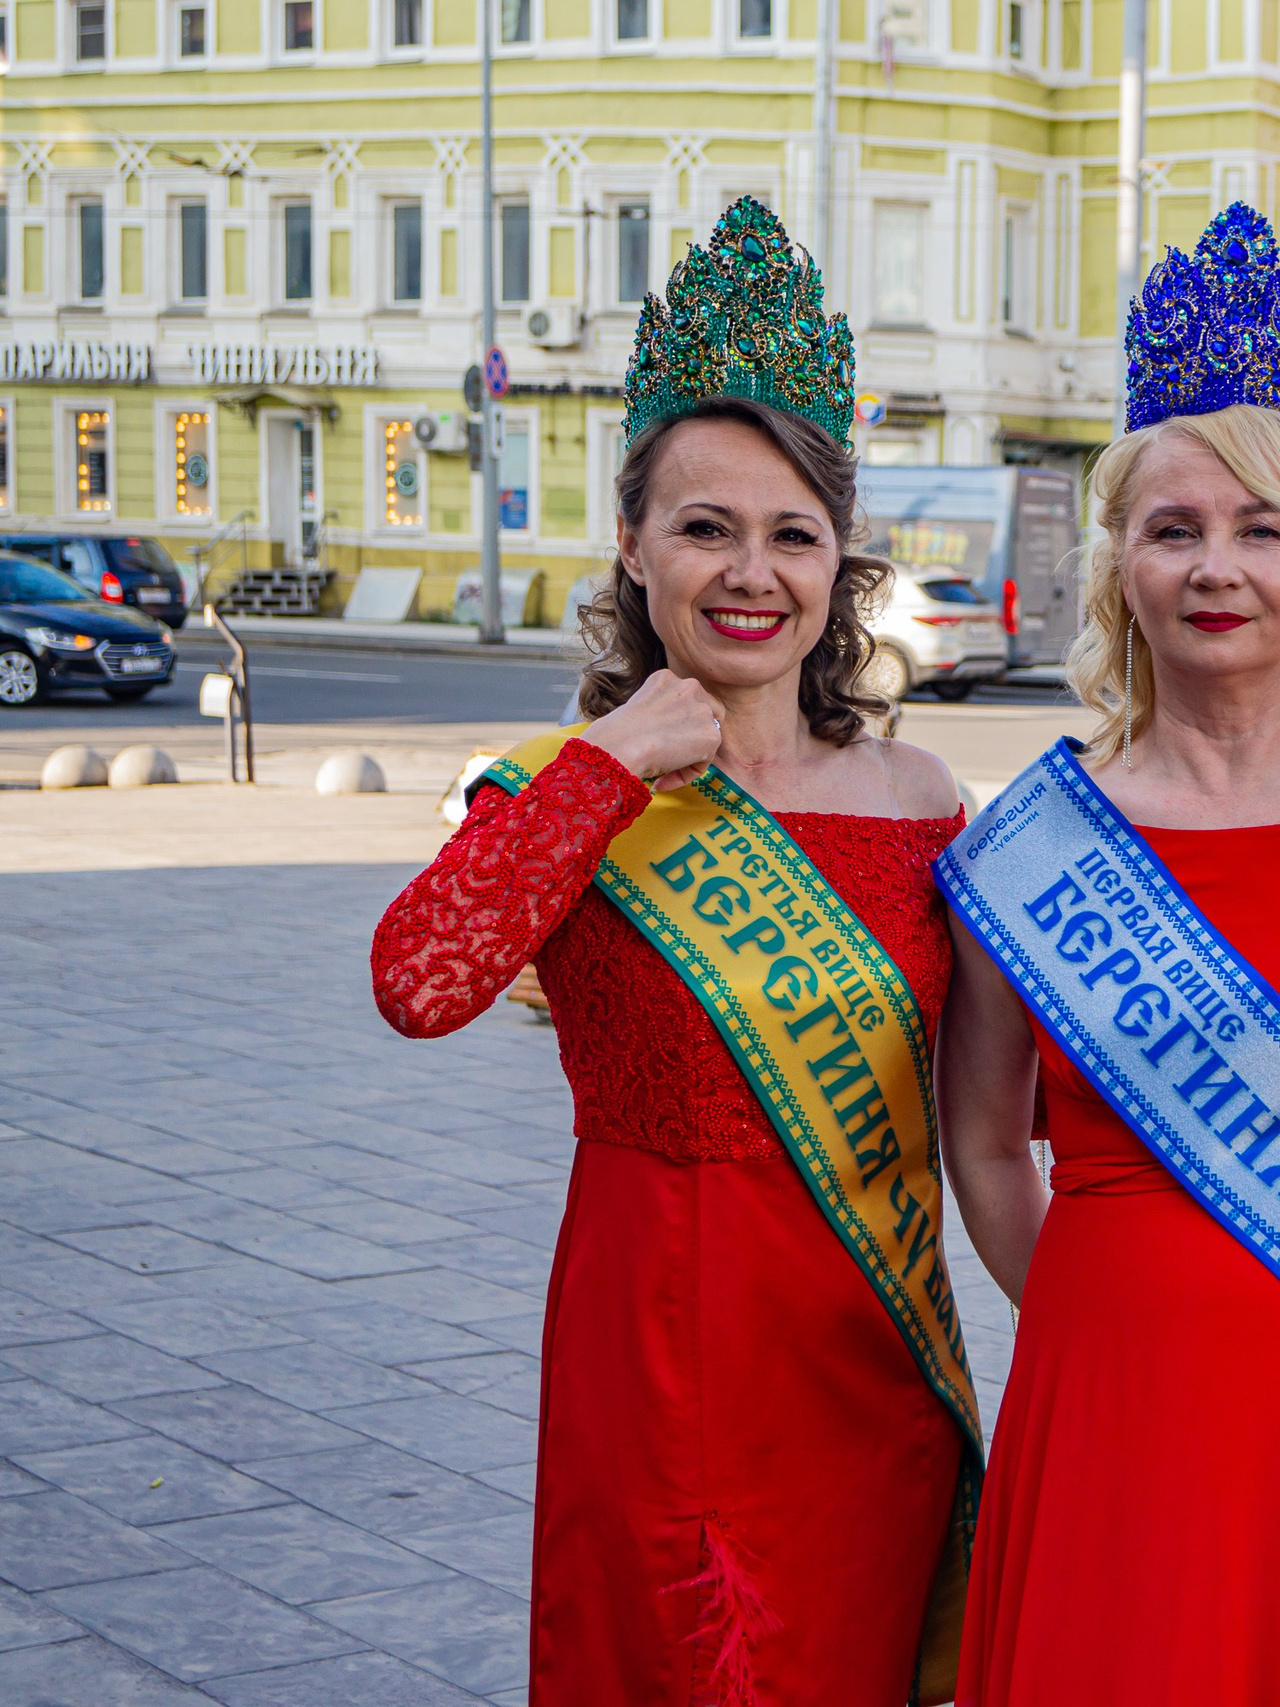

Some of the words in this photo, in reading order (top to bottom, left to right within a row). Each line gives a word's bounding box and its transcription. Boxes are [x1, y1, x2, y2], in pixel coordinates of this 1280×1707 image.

[0, 341, 151, 380] ПАРИЛЬНЯ
[186, 343, 379, 385] ЧИНИЛЬНЯ
[967, 782, 1047, 860] берегиня
[990, 811, 1039, 853] ЧУВАШИИ
[706, 815, 821, 939] ТРЕТЬЯ
[810, 939, 885, 1031] ВИЦЕ
[1075, 848, 1178, 964] ПЕРВАЯ
[1163, 959, 1245, 1042] ВИЦЕ
[649, 834, 902, 1189] БЕРЕГИНЯ
